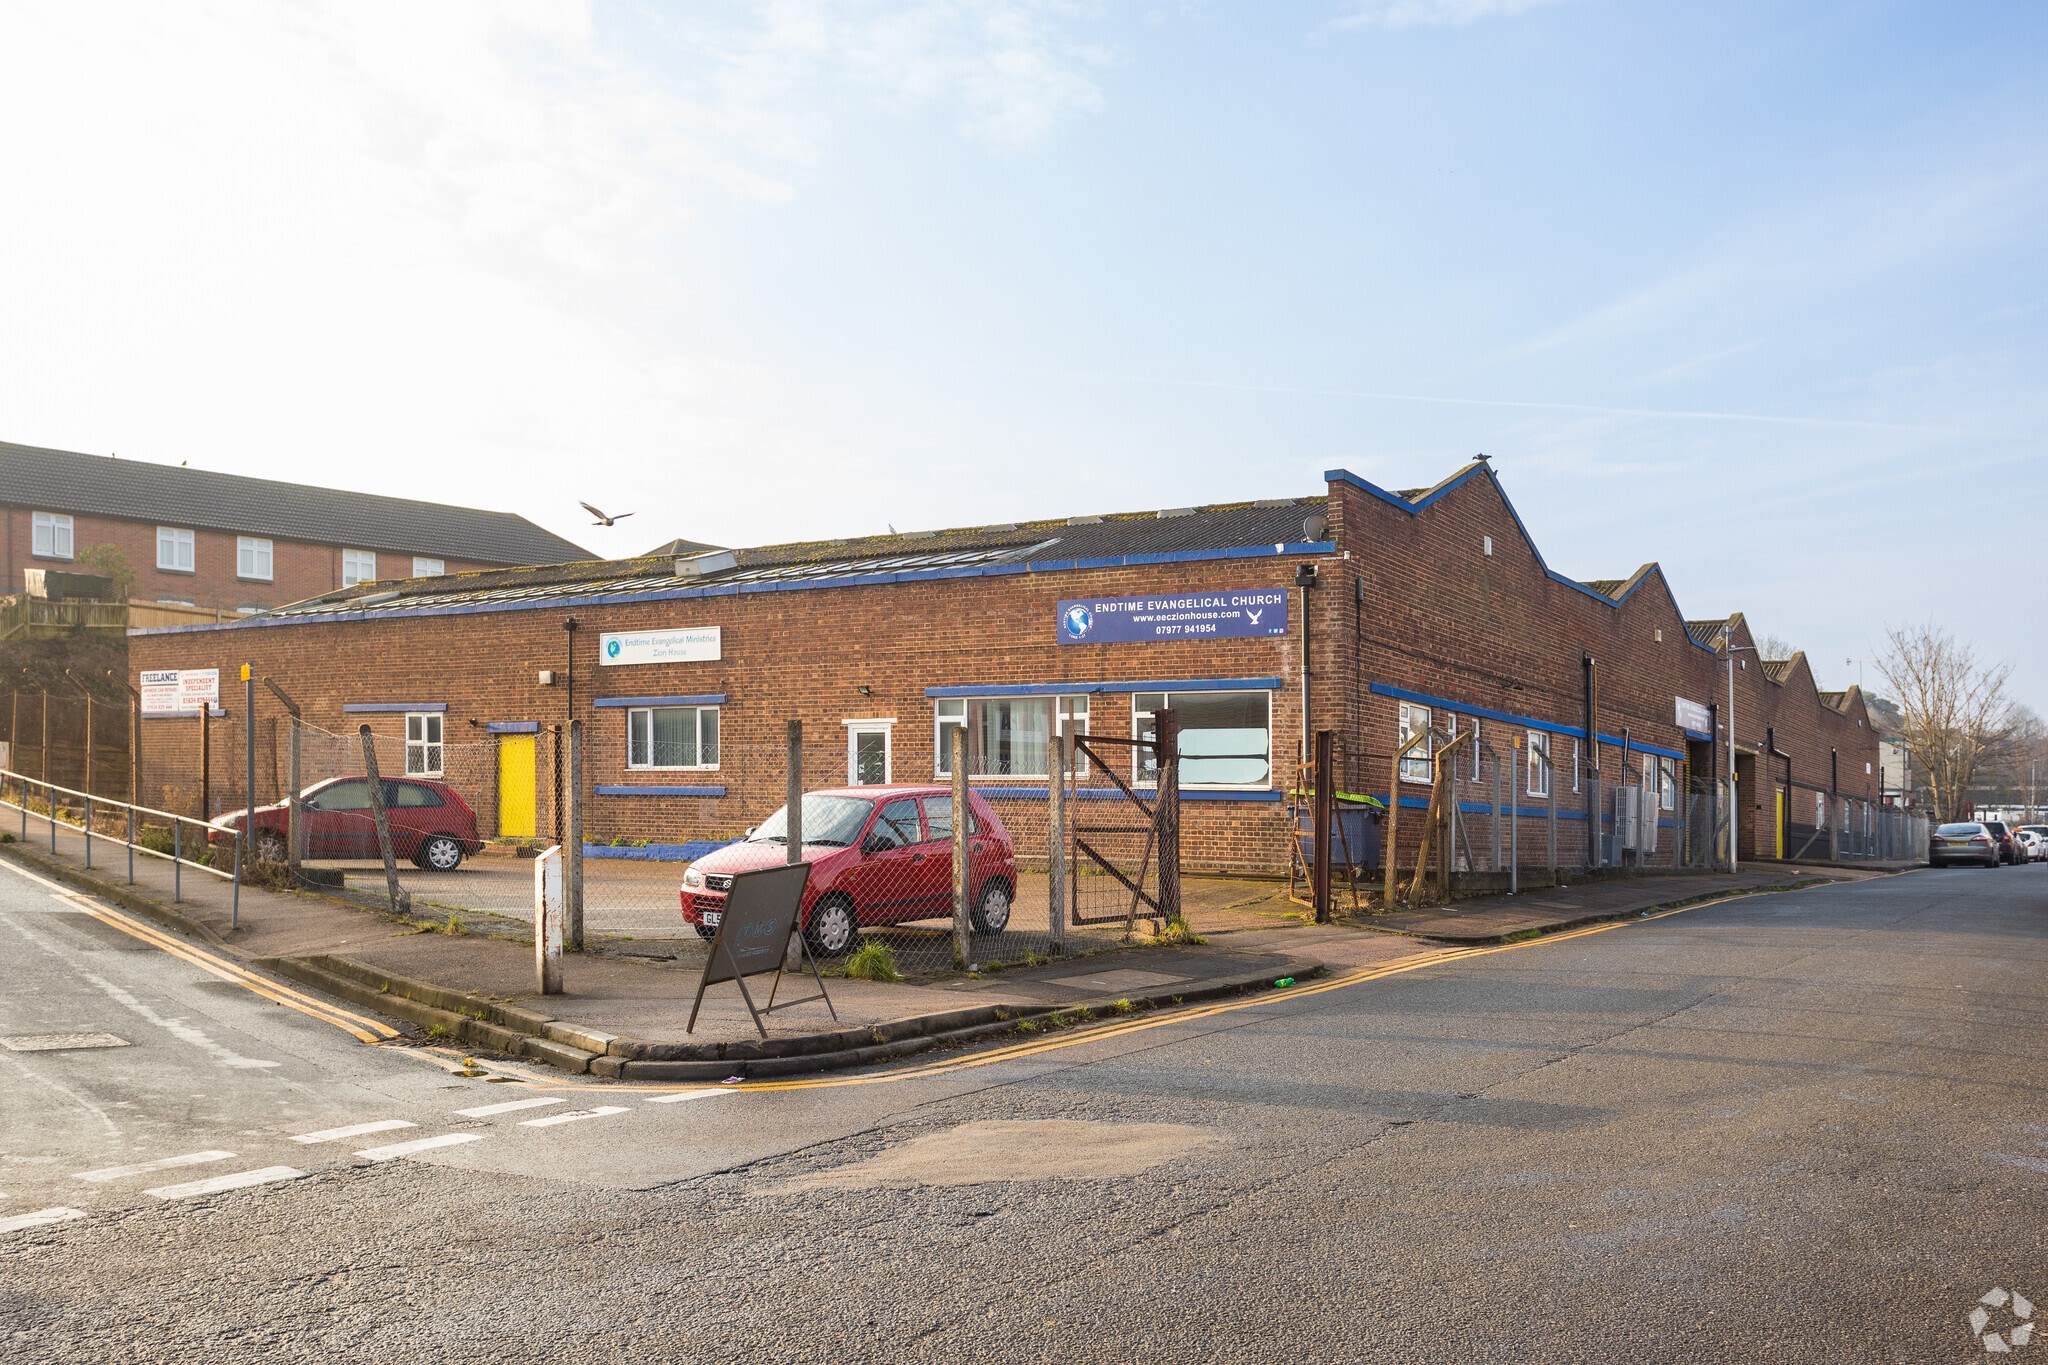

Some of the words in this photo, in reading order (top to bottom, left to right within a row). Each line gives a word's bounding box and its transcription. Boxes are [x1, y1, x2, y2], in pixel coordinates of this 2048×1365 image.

[1095, 602, 1144, 613] ENDTIME
[1147, 597, 1228, 611] EVANGELICAL
[1231, 594, 1282, 606] CHURCH
[1133, 611, 1241, 623] www.eeczionhouse.com
[1155, 625, 1182, 635] 07977
[1184, 623, 1217, 634] 941954
[625, 638, 650, 647] Endtime
[651, 636, 685, 648] Evangelical
[686, 634, 717, 643] Ministries
[653, 648, 667, 657] Zion
[668, 647, 688, 656] House
[142, 672, 178, 683] FREELANCE
[706, 913, 721, 924] GL5
